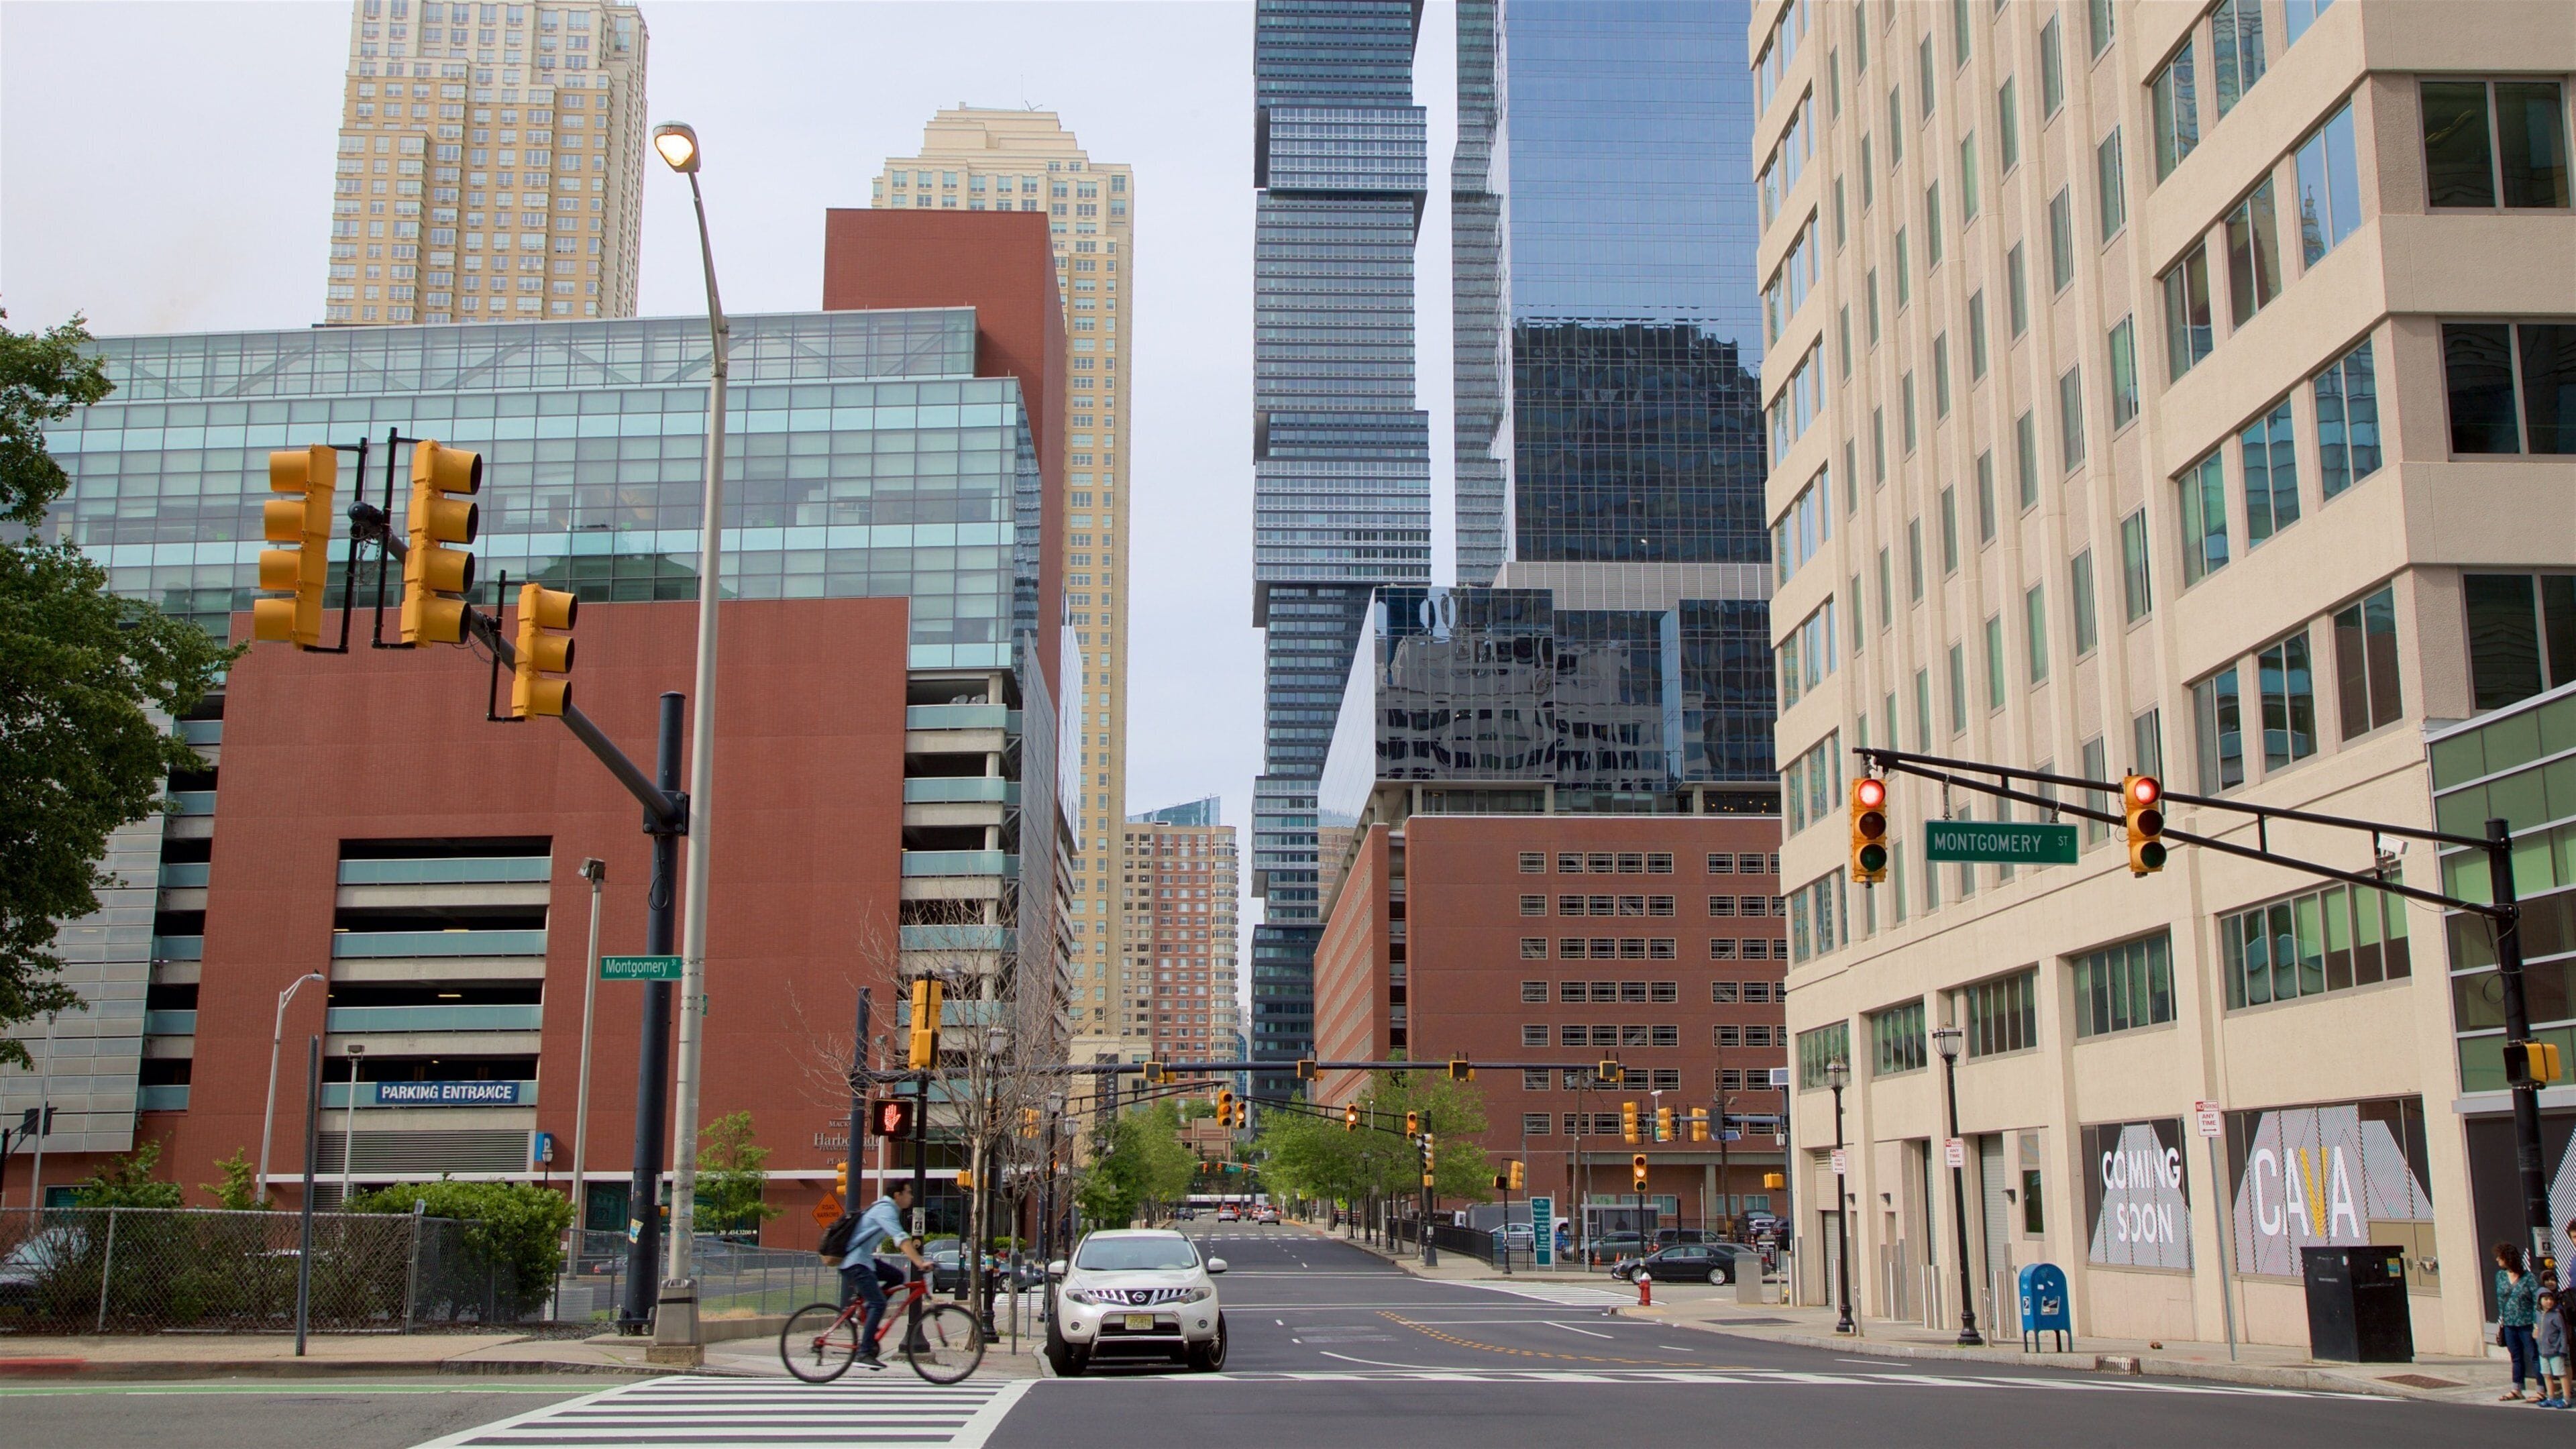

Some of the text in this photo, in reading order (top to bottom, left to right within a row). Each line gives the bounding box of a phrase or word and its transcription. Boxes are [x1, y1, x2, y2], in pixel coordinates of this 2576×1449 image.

[1934, 833, 2068, 853] MONTGOMERY ST
[606, 959, 668, 977] Montgomery
[382, 1085, 512, 1099] PARKING ENTRANCE
[2102, 1147, 2181, 1189] COMING
[2255, 1146, 2360, 1238] CAVA
[2116, 1203, 2174, 1244] SOON
